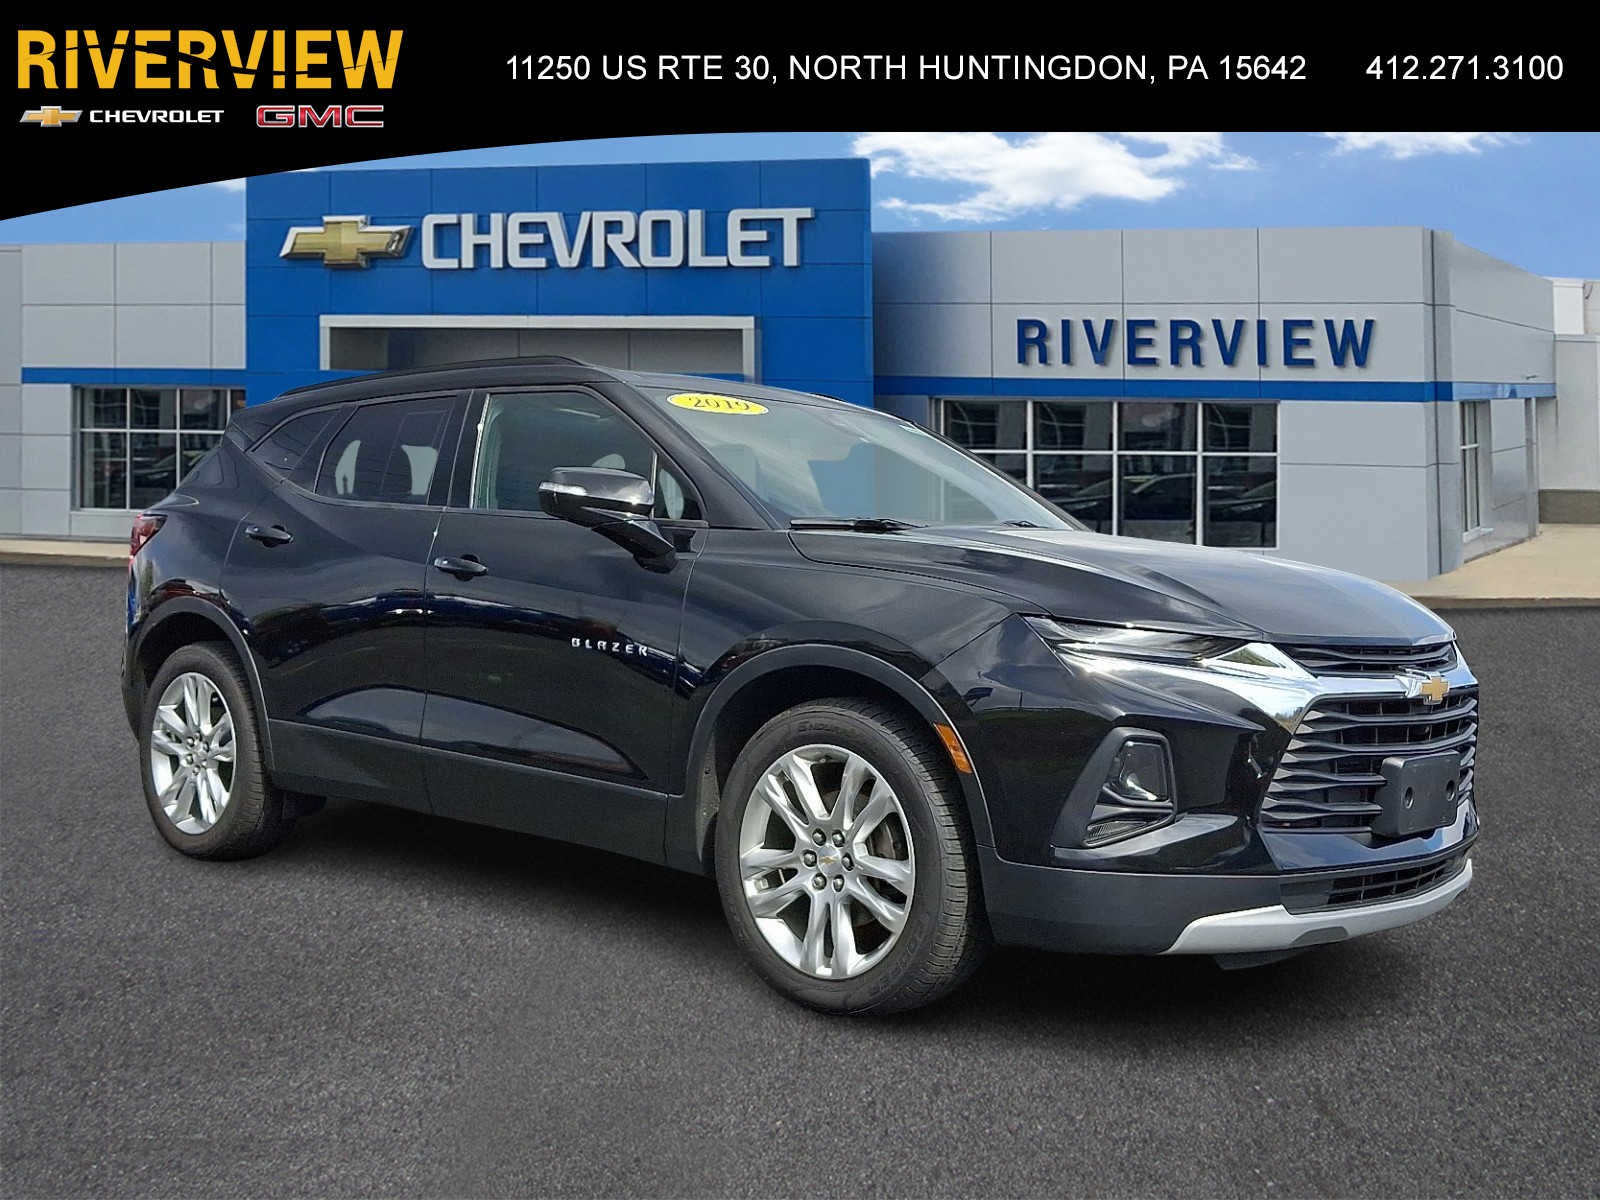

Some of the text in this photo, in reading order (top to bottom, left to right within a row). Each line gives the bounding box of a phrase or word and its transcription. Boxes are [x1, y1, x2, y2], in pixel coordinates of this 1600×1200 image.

[421, 207, 814, 269] CHEVROLET
[1016, 318, 1376, 369] RIVERVIEW
[689, 396, 750, 411] 2019
[571, 637, 648, 657] BLAZER
